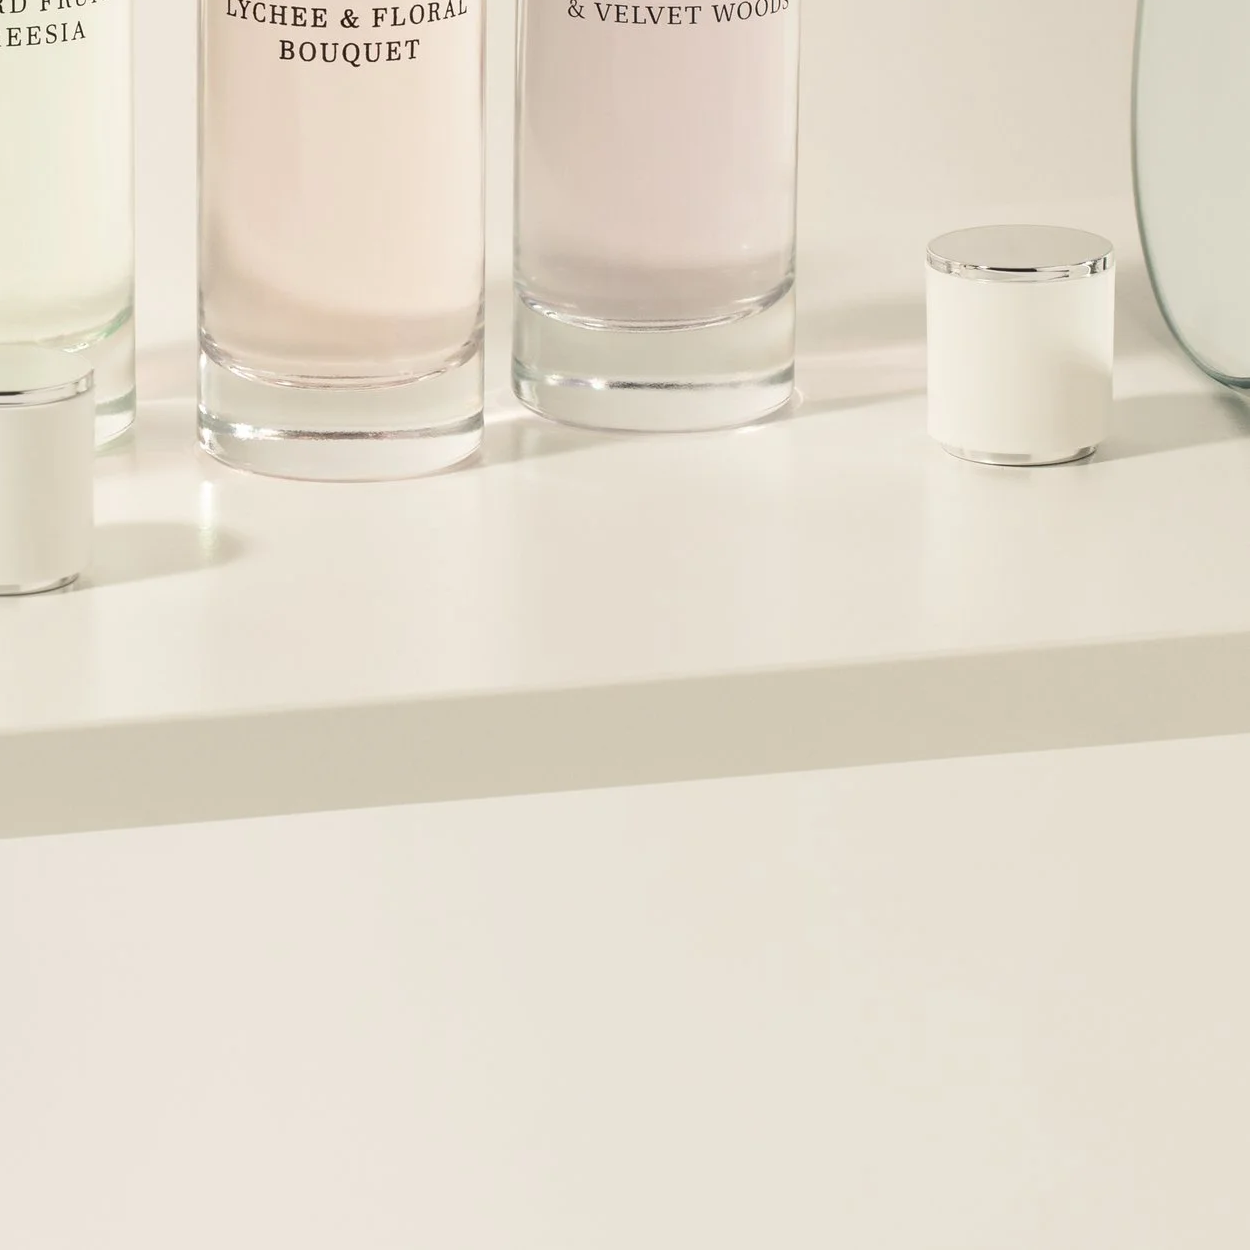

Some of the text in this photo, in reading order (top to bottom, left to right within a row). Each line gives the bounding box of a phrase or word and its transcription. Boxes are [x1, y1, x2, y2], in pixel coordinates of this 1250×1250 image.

[339, 8, 361, 29] &
[593, 1, 703, 26] VELVET
[278, 38, 421, 69] BOUQUET
